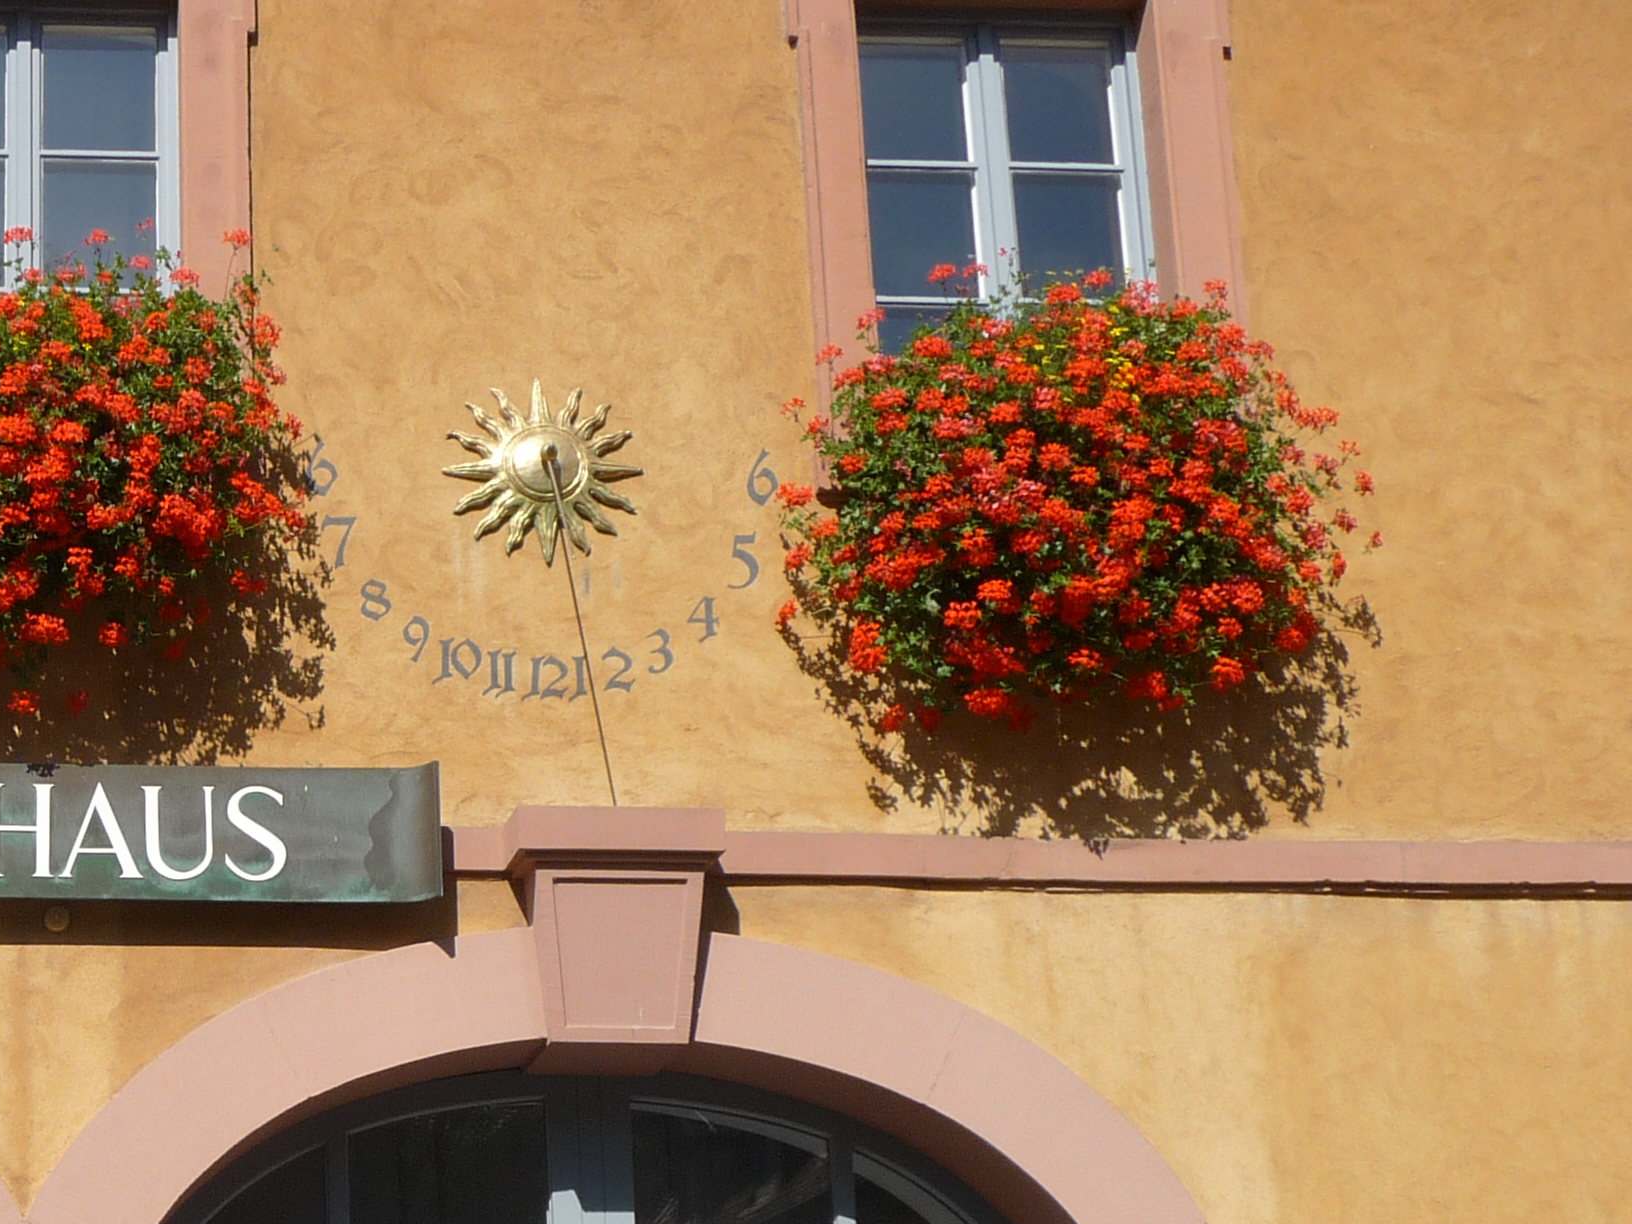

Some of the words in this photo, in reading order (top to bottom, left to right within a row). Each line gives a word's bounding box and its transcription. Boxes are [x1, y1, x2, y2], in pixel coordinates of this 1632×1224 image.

[321, 514, 357, 569] 7
[360, 578, 392, 621] 8
[402, 615, 430, 662] 9
[431, 637, 482, 684] 10
[601, 646, 636, 692] 2
[646, 628, 674, 674] 3
[687, 595, 721, 643] 4
[727, 531, 759, 589] 5
[747, 448, 779, 506] 6
